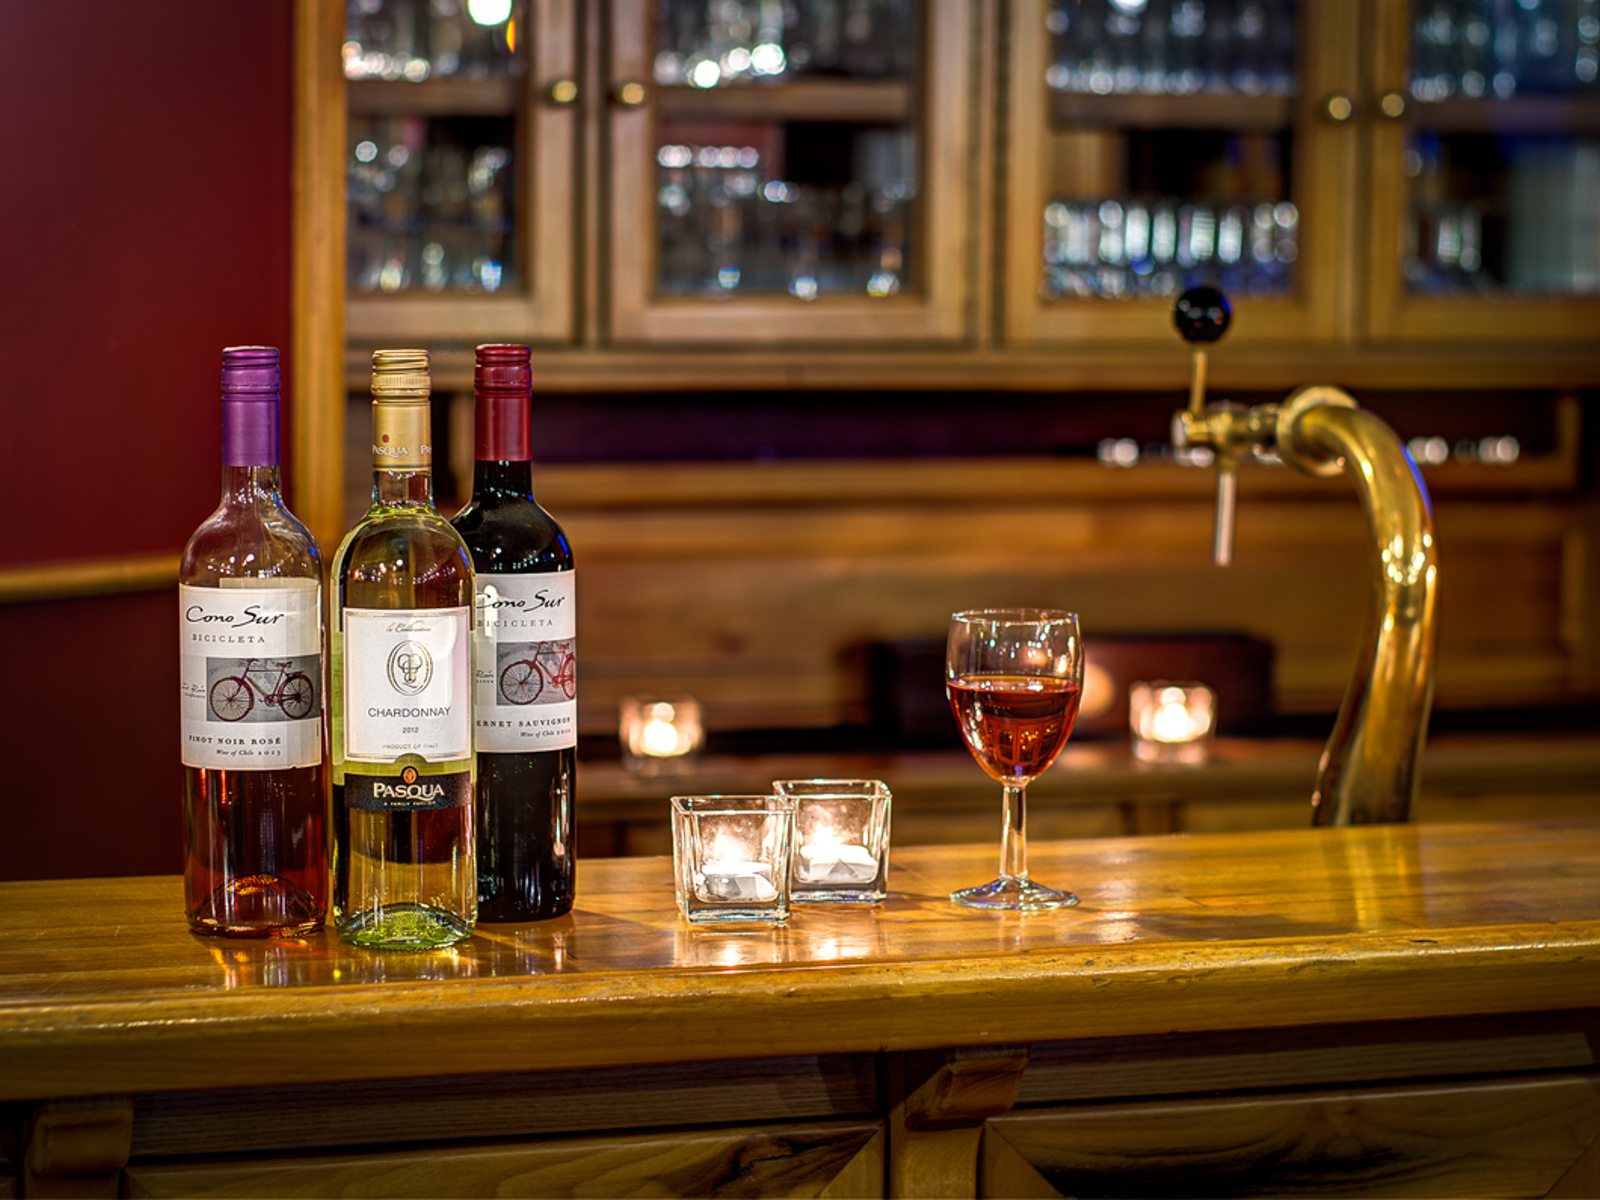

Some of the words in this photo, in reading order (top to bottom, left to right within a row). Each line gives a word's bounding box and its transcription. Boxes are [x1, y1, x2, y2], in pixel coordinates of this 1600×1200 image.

[523, 589, 565, 613] Sur
[185, 605, 234, 622] Cono
[232, 604, 284, 628] Sur
[477, 619, 554, 628] BICICLETA
[192, 633, 266, 644] BICICLETA
[367, 706, 451, 718] CHARDONNAY
[402, 726, 419, 734] 2012
[188, 734, 213, 744] PINOT
[218, 737, 245, 745] NOIR
[251, 736, 282, 745] ROSÉ
[372, 782, 446, 802] PASQUA
